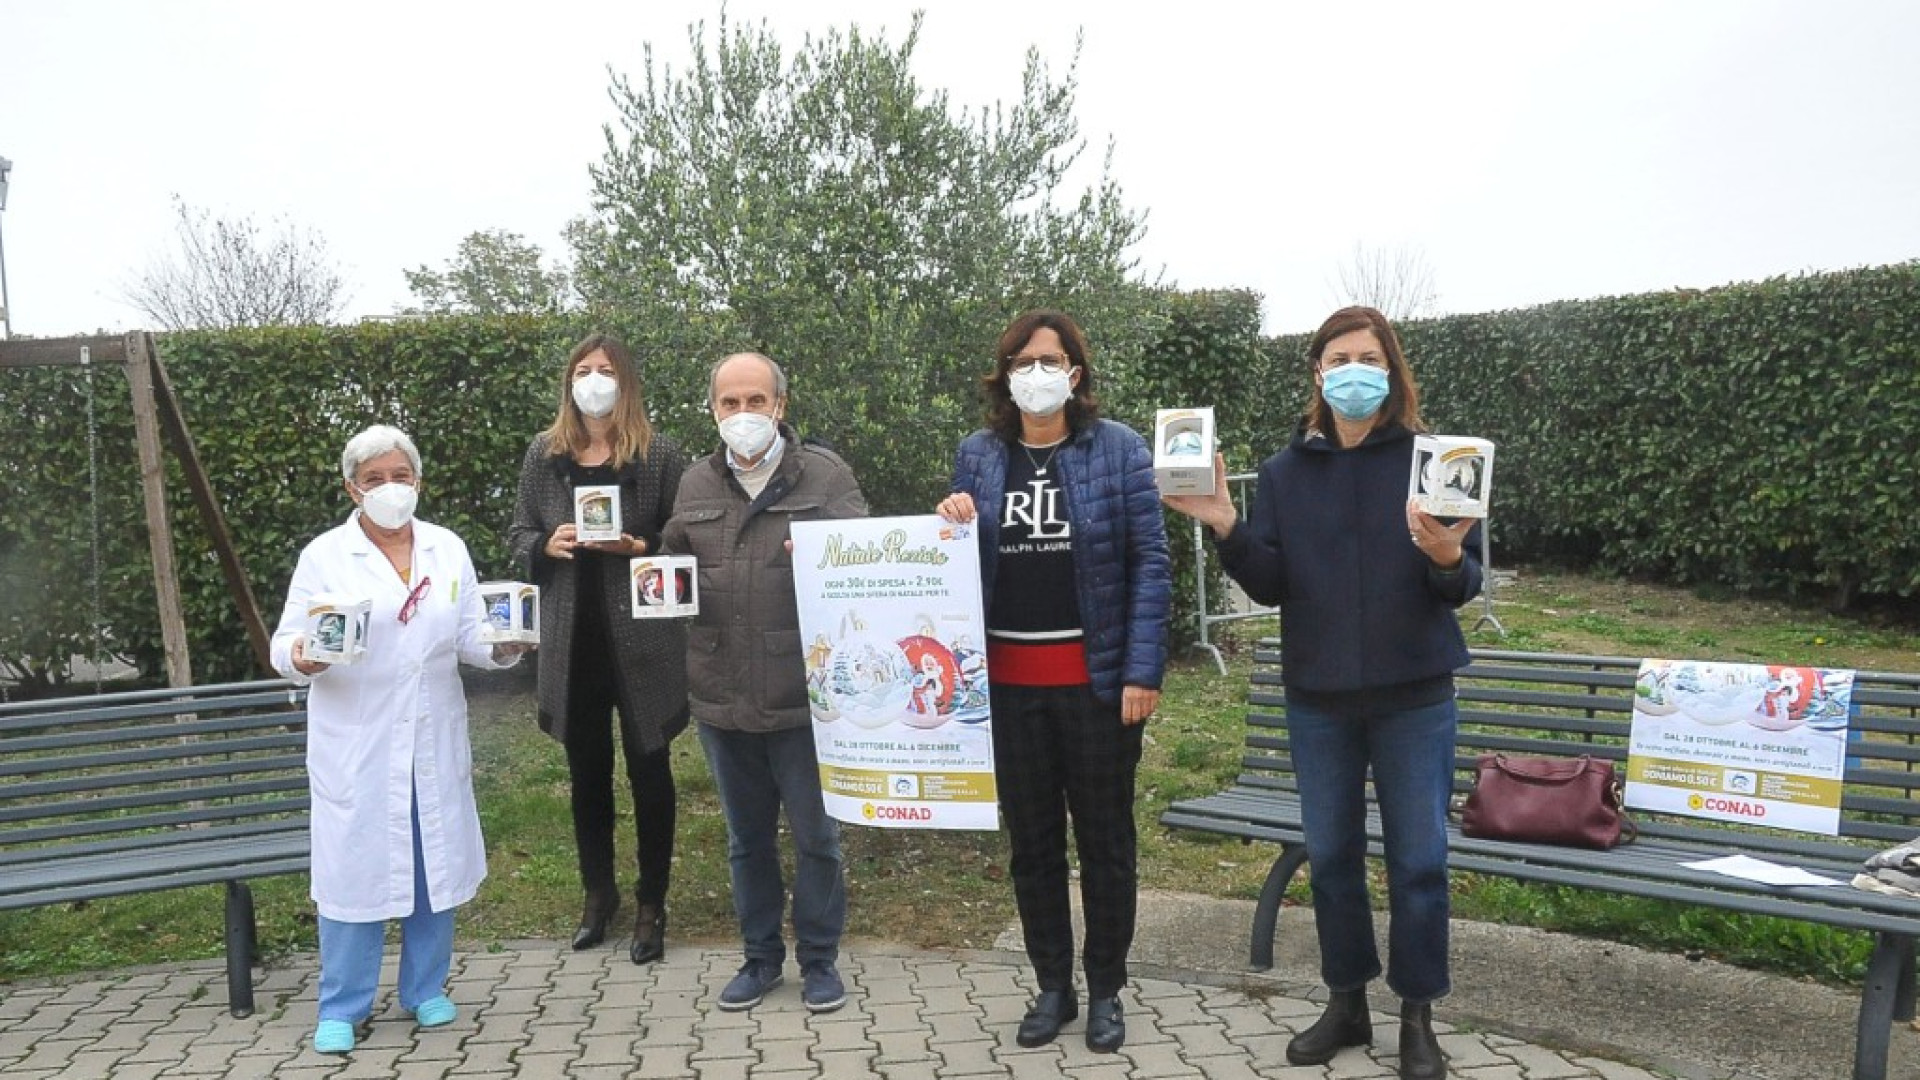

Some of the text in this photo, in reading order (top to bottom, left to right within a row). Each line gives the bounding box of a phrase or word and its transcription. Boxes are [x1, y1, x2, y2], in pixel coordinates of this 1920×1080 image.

[817, 531, 883, 570] Natale
[1036, 542, 1072, 552] LAURE
[878, 578, 906, 588] SPESA
[858, 742, 896, 750] OTTOBRE
[916, 743, 960, 752] DICEMBRE
[1664, 732, 1680, 741] DAL
[1684, 734, 1694, 743] 28
[1696, 736, 1736, 748] OTTOBRE
[1762, 742, 1809, 756] DICEMBRE
[876, 806, 932, 820] CONAD
[1705, 798, 1766, 816] CONAD
